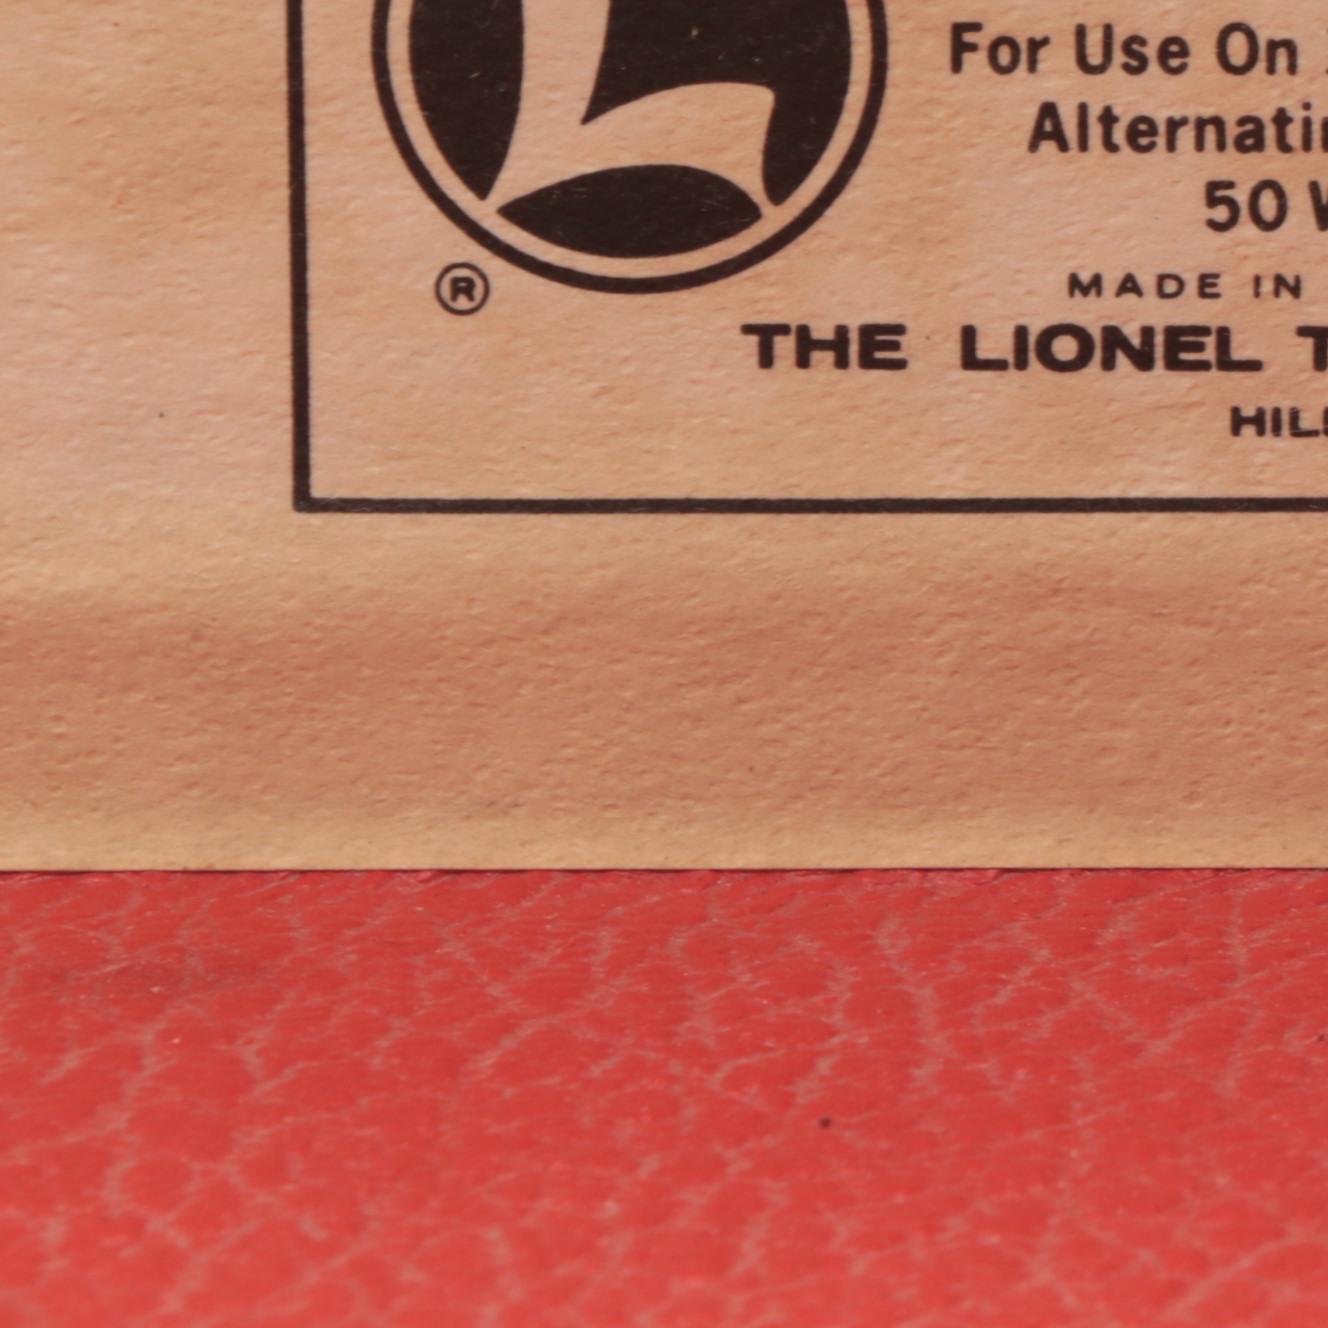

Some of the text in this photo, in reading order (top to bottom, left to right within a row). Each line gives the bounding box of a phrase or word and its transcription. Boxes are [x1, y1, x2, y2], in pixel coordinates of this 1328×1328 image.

[950, 21, 1051, 76] For
[1074, 22, 1191, 76] Use
[1215, 21, 1298, 76] On
[1204, 178, 1289, 233] 50
[1067, 272, 1223, 301] MADE
[1253, 273, 1303, 301] IN
[740, 322, 909, 372] THE
[960, 322, 1265, 374] LIONEL
